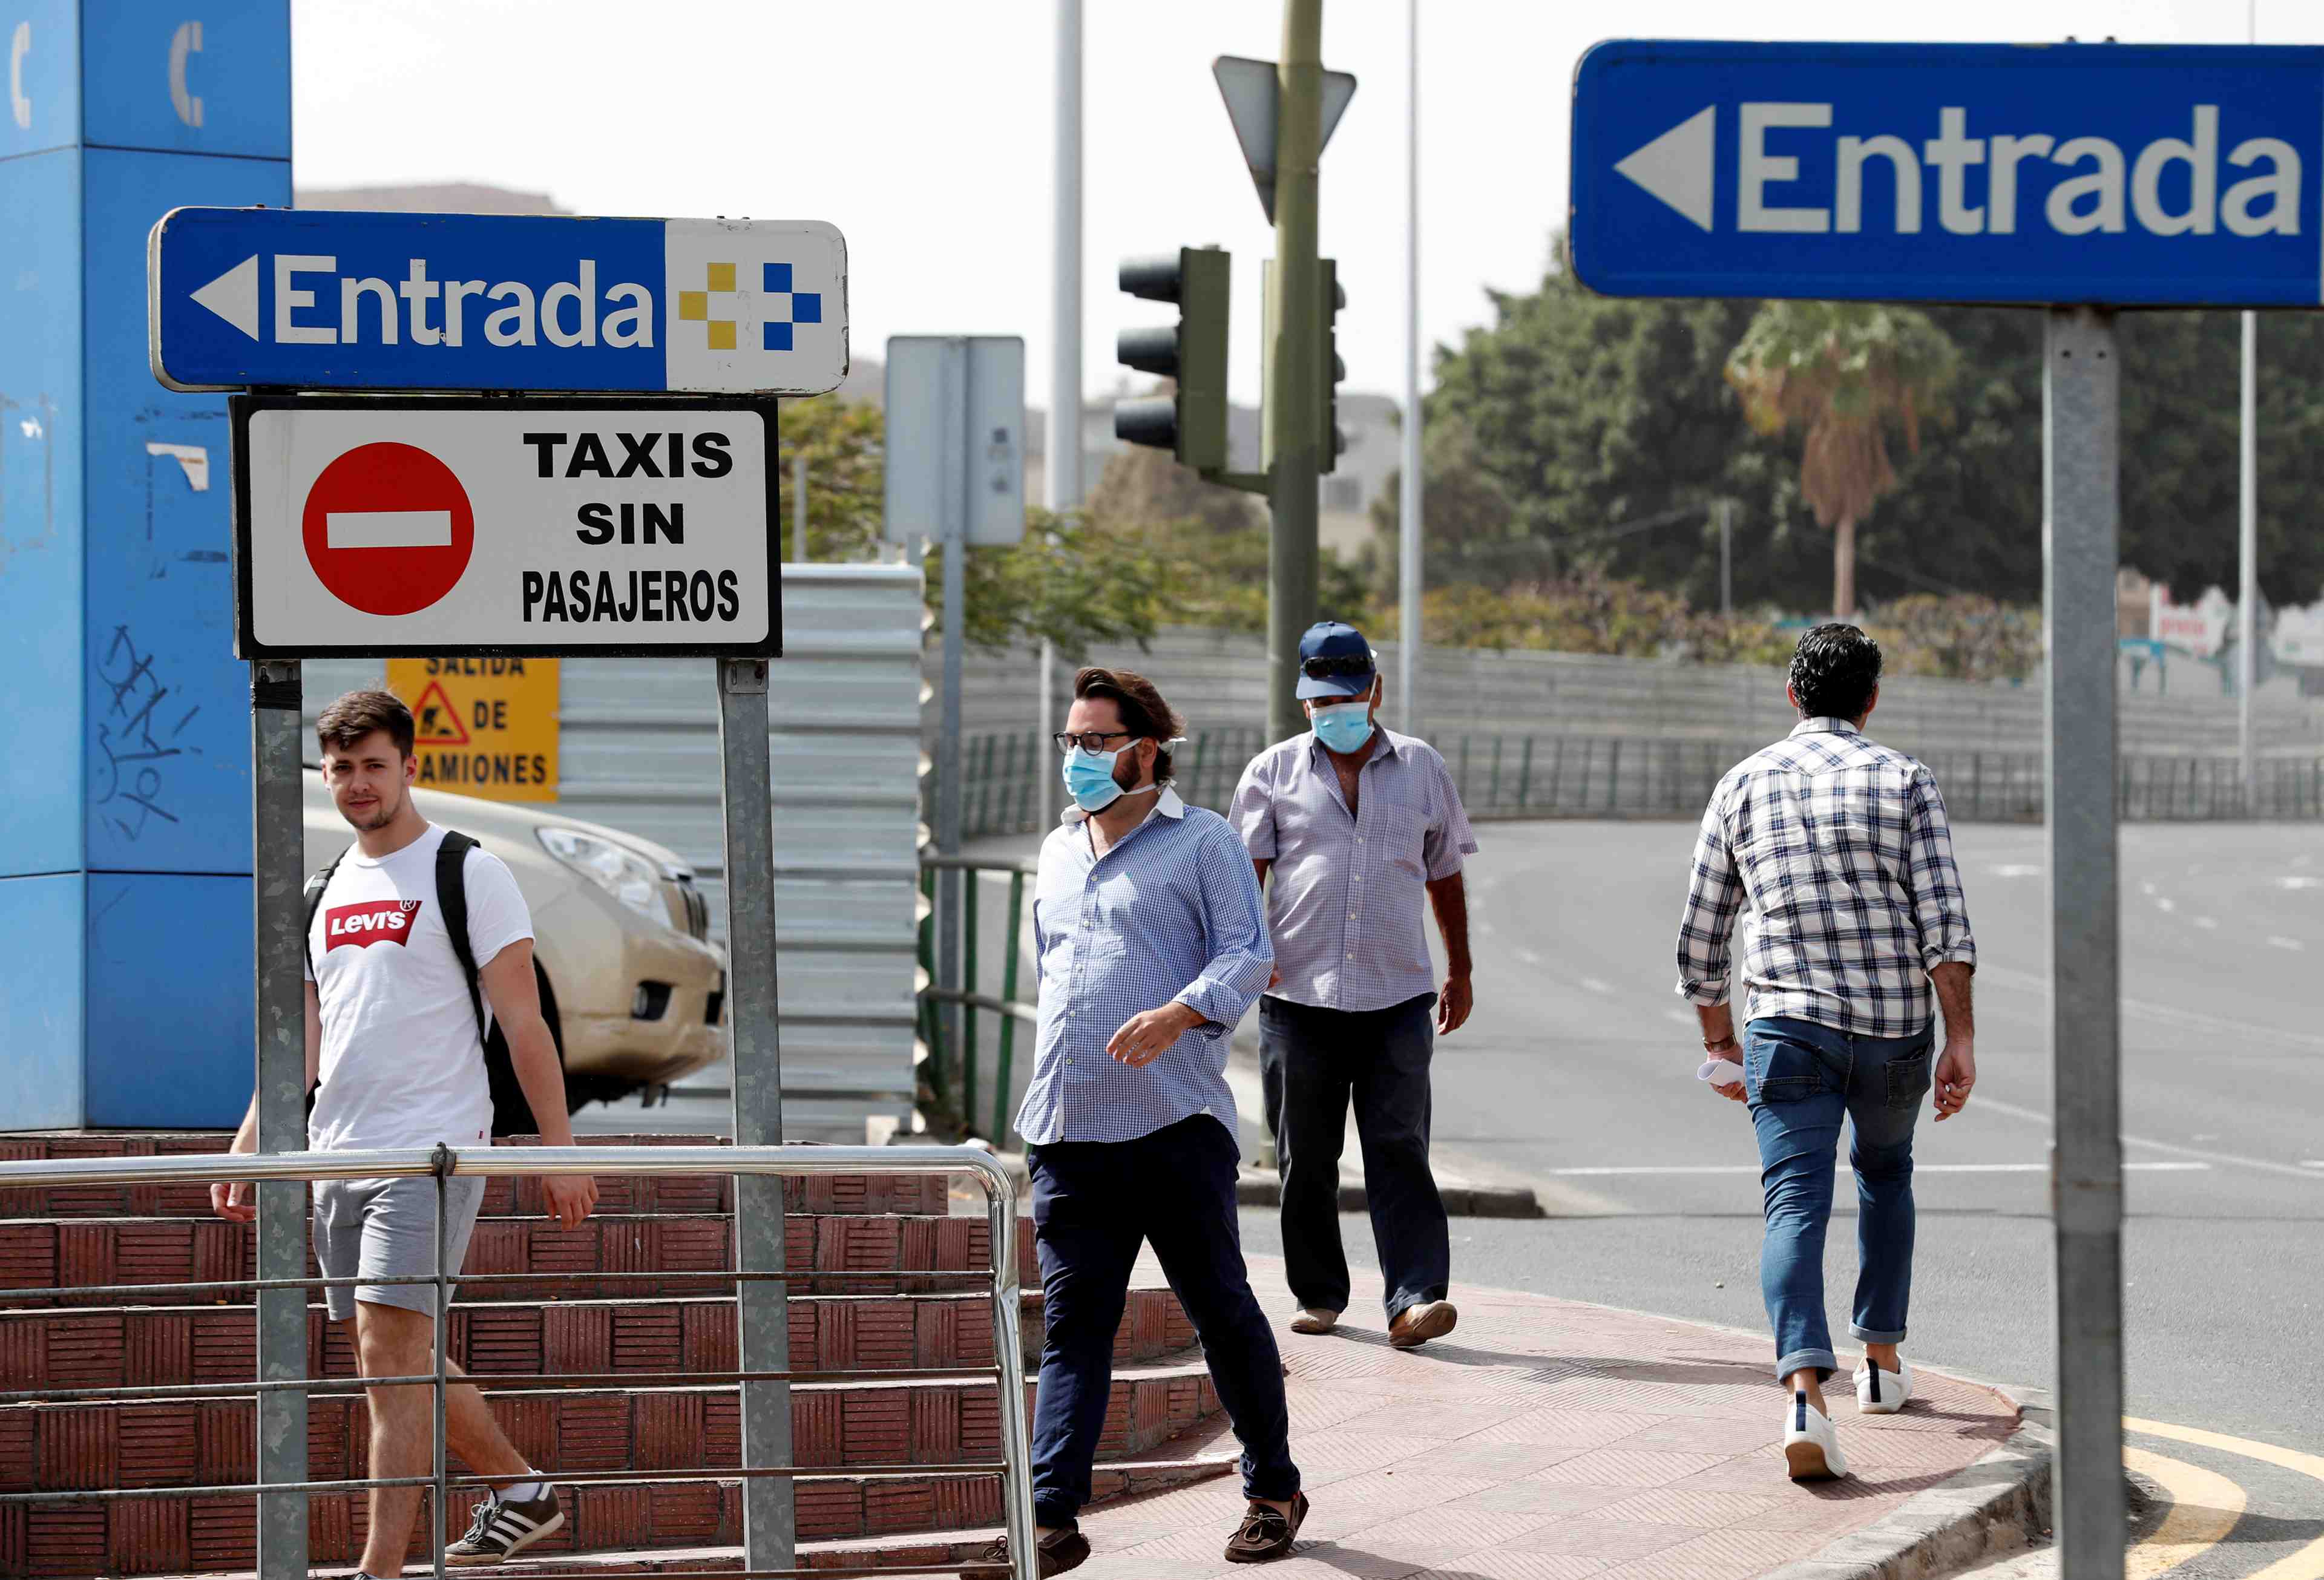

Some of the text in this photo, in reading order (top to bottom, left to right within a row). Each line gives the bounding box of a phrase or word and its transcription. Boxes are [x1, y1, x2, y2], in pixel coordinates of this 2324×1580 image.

[1737, 102, 2302, 237] Entrada
[274, 253, 655, 349] Entrada
[522, 431, 734, 479] TAXIS
[576, 502, 684, 546] SIN
[522, 569, 740, 623] PASAJEROS
[473, 700, 507, 730] DE
[419, 754, 547, 784] AMIONES
